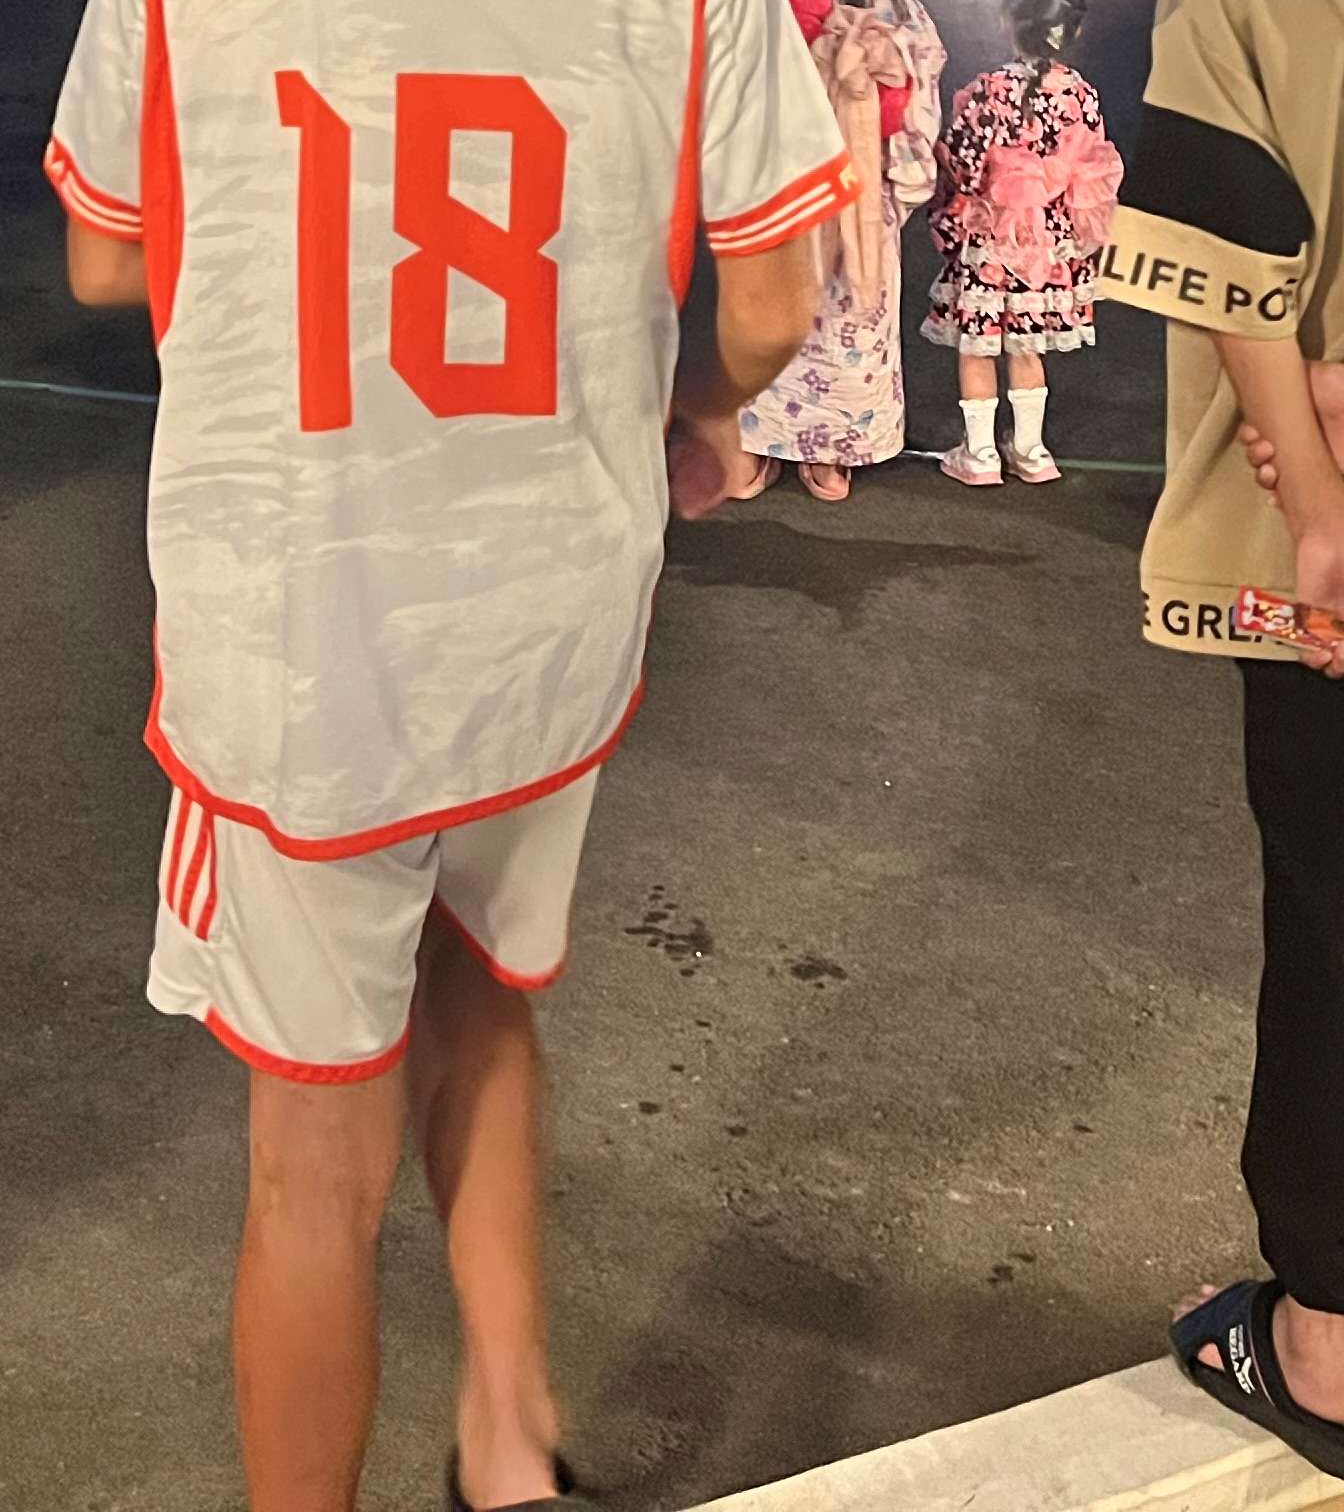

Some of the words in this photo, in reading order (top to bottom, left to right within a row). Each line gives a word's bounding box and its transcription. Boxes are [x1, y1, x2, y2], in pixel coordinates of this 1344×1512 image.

[274, 70, 568, 432] 18
[1102, 244, 1208, 306] LIFE
[1225, 278, 1299, 322] PO
